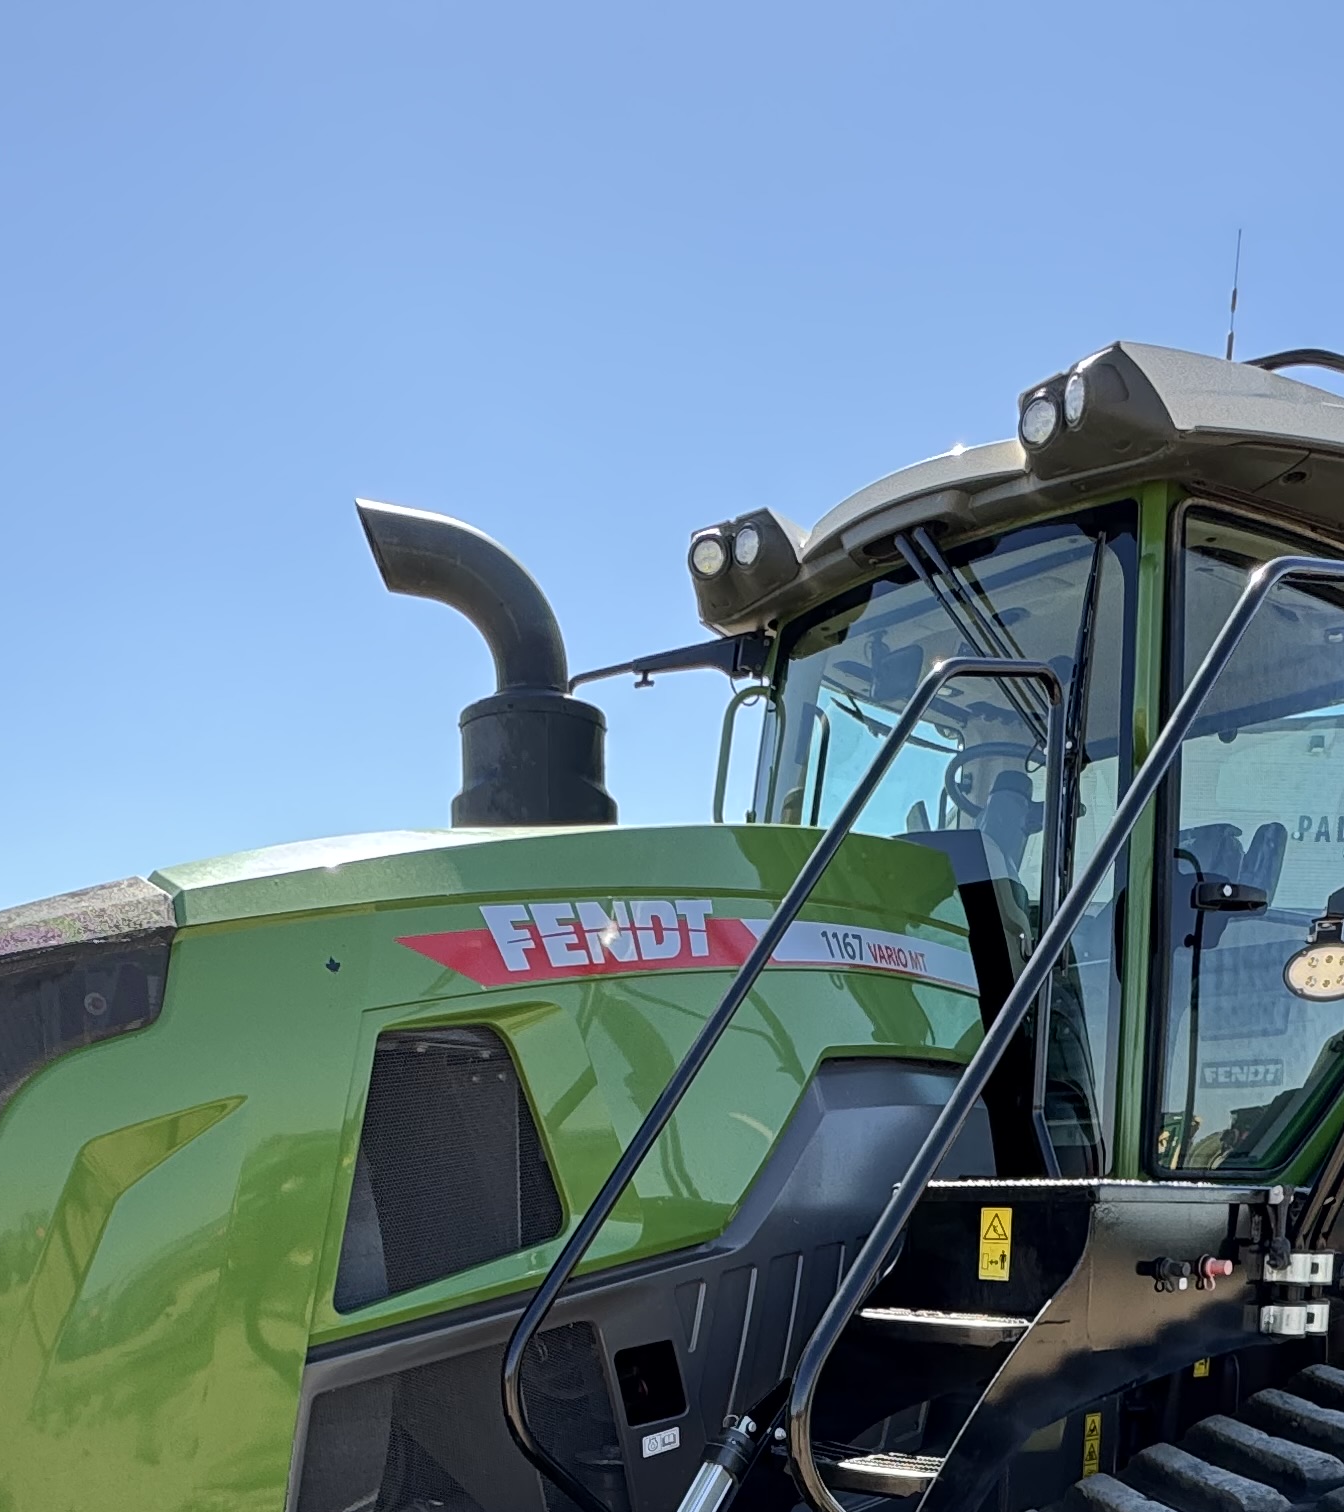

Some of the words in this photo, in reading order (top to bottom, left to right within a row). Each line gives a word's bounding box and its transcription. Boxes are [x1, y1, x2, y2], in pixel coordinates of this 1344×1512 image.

[479, 899, 713, 972] FENDT
[820, 930, 863, 961] 1167
[867, 941, 908, 968] VARIO
[908, 949, 928, 973] MT
[1203, 1064, 1283, 1083] FENDT
